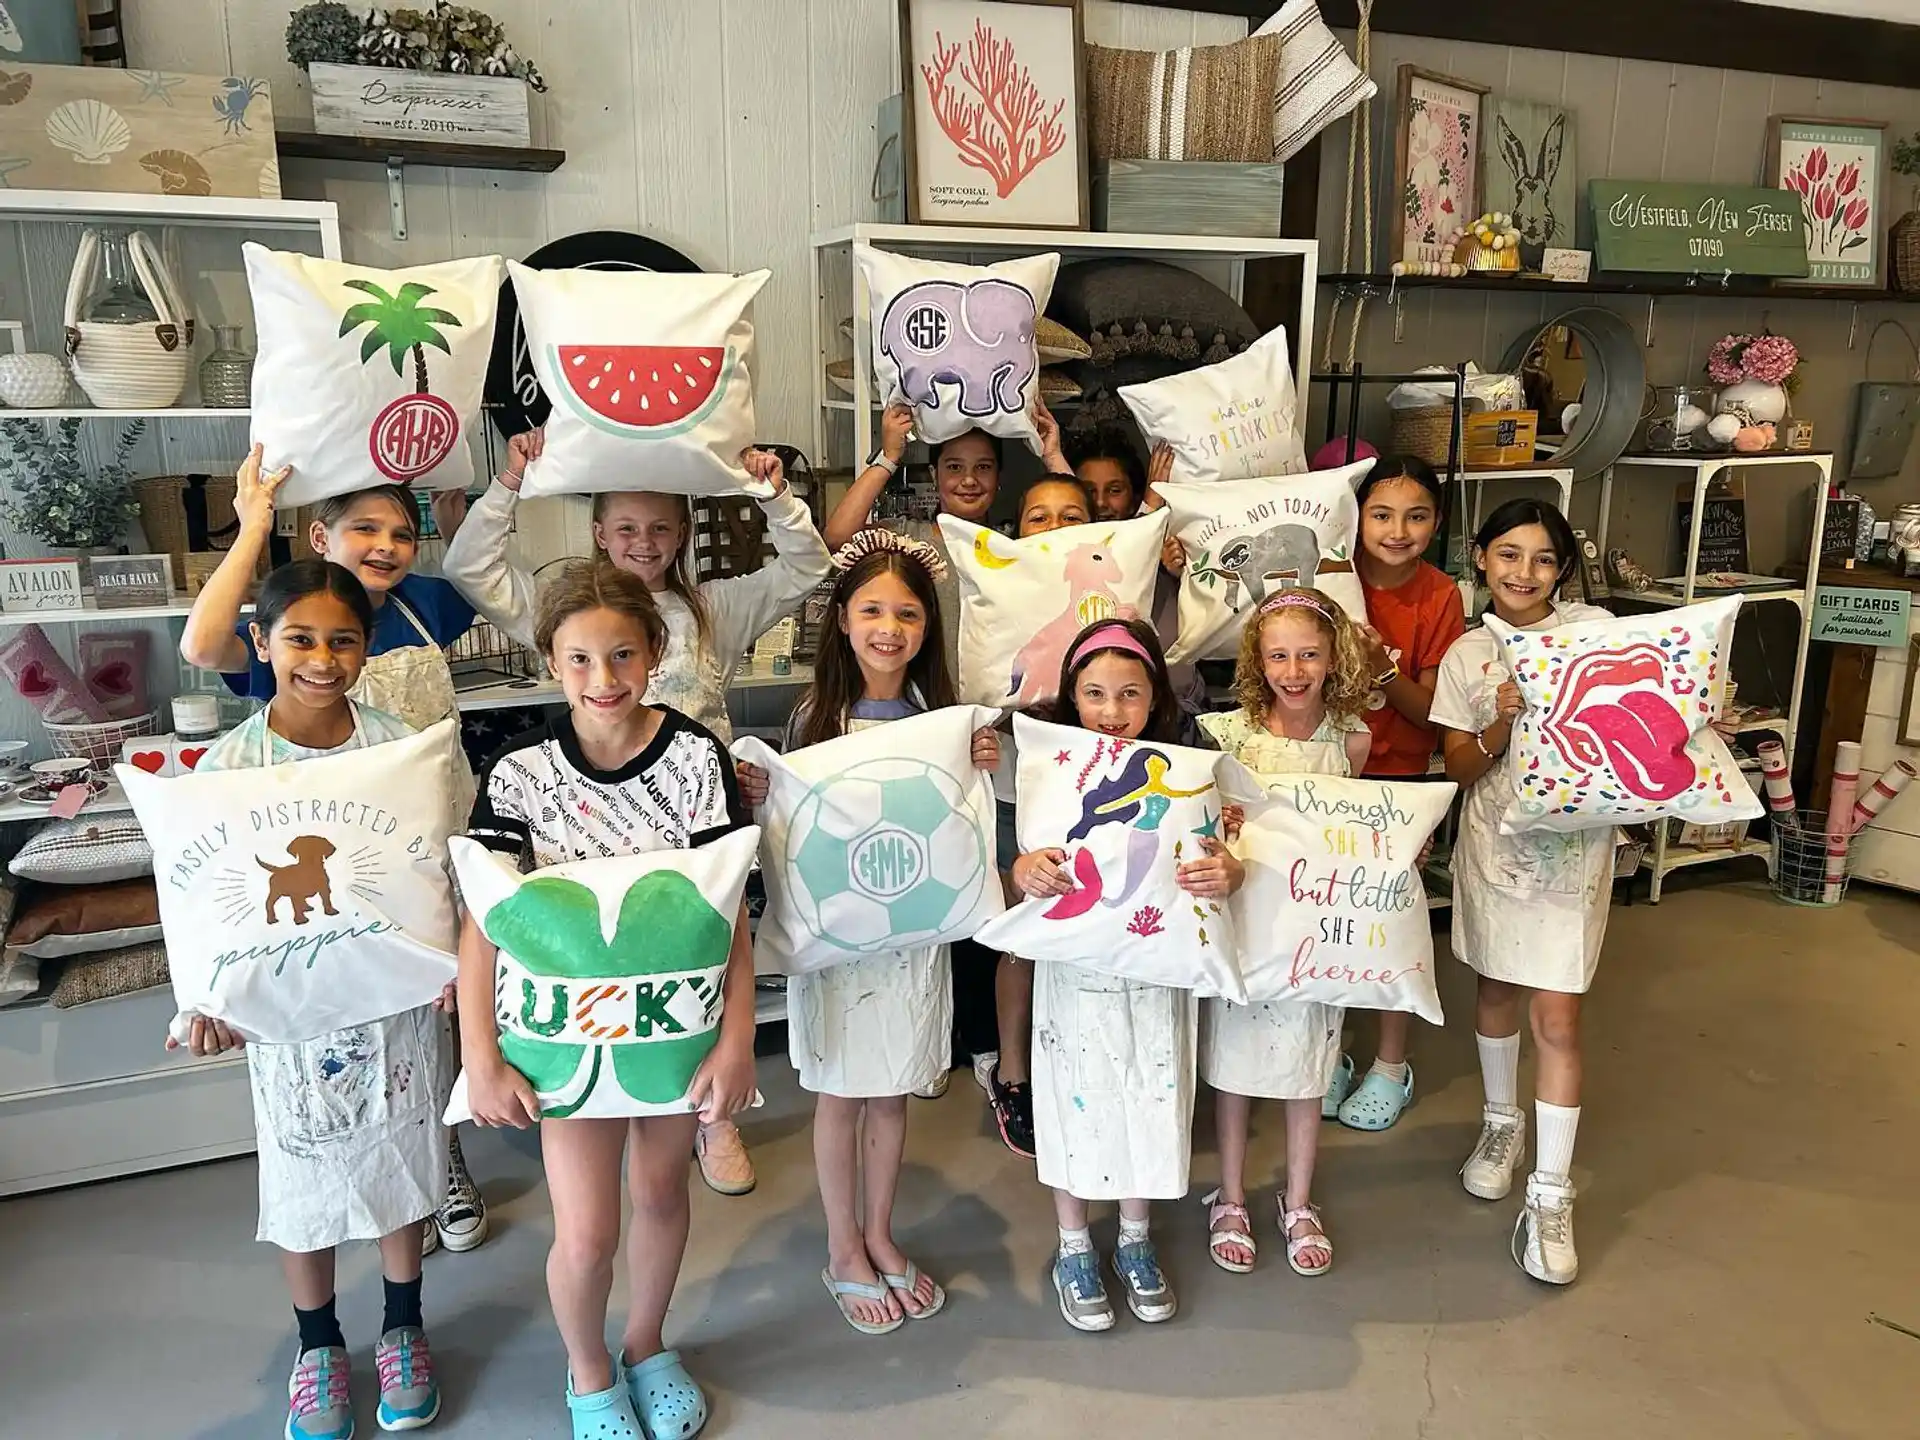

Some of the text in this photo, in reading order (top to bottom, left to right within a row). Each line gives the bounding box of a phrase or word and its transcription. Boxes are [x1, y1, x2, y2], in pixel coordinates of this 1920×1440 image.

[393, 119, 455, 132] est. 2010
[929, 186, 990, 196] SOFT CORAL
[1689, 238, 1724, 257] 07090
[1810, 263, 1871, 279] TFIELD
[905, 307, 947, 349] GSE
[1246, 500, 1277, 525] NOT
[8, 569, 74, 593] AVALON
[98, 572, 159, 588] BEACH HAVEN
[1820, 594, 1900, 612] GIFT CARDS
[1821, 623, 1892, 638] for purchase!
[1831, 613, 1884, 625] Available
[617, 786, 665, 832] CURRENTLY
[1269, 780, 1415, 832] though
[170, 799, 433, 891] EASILY DISTRACTED BY
[1324, 826, 1394, 861] SHE BE
[1290, 858, 1415, 912] but little
[1320, 917, 1387, 948] SHE IS
[209, 911, 402, 992] puppie
[1288, 936, 1426, 989] fierce
